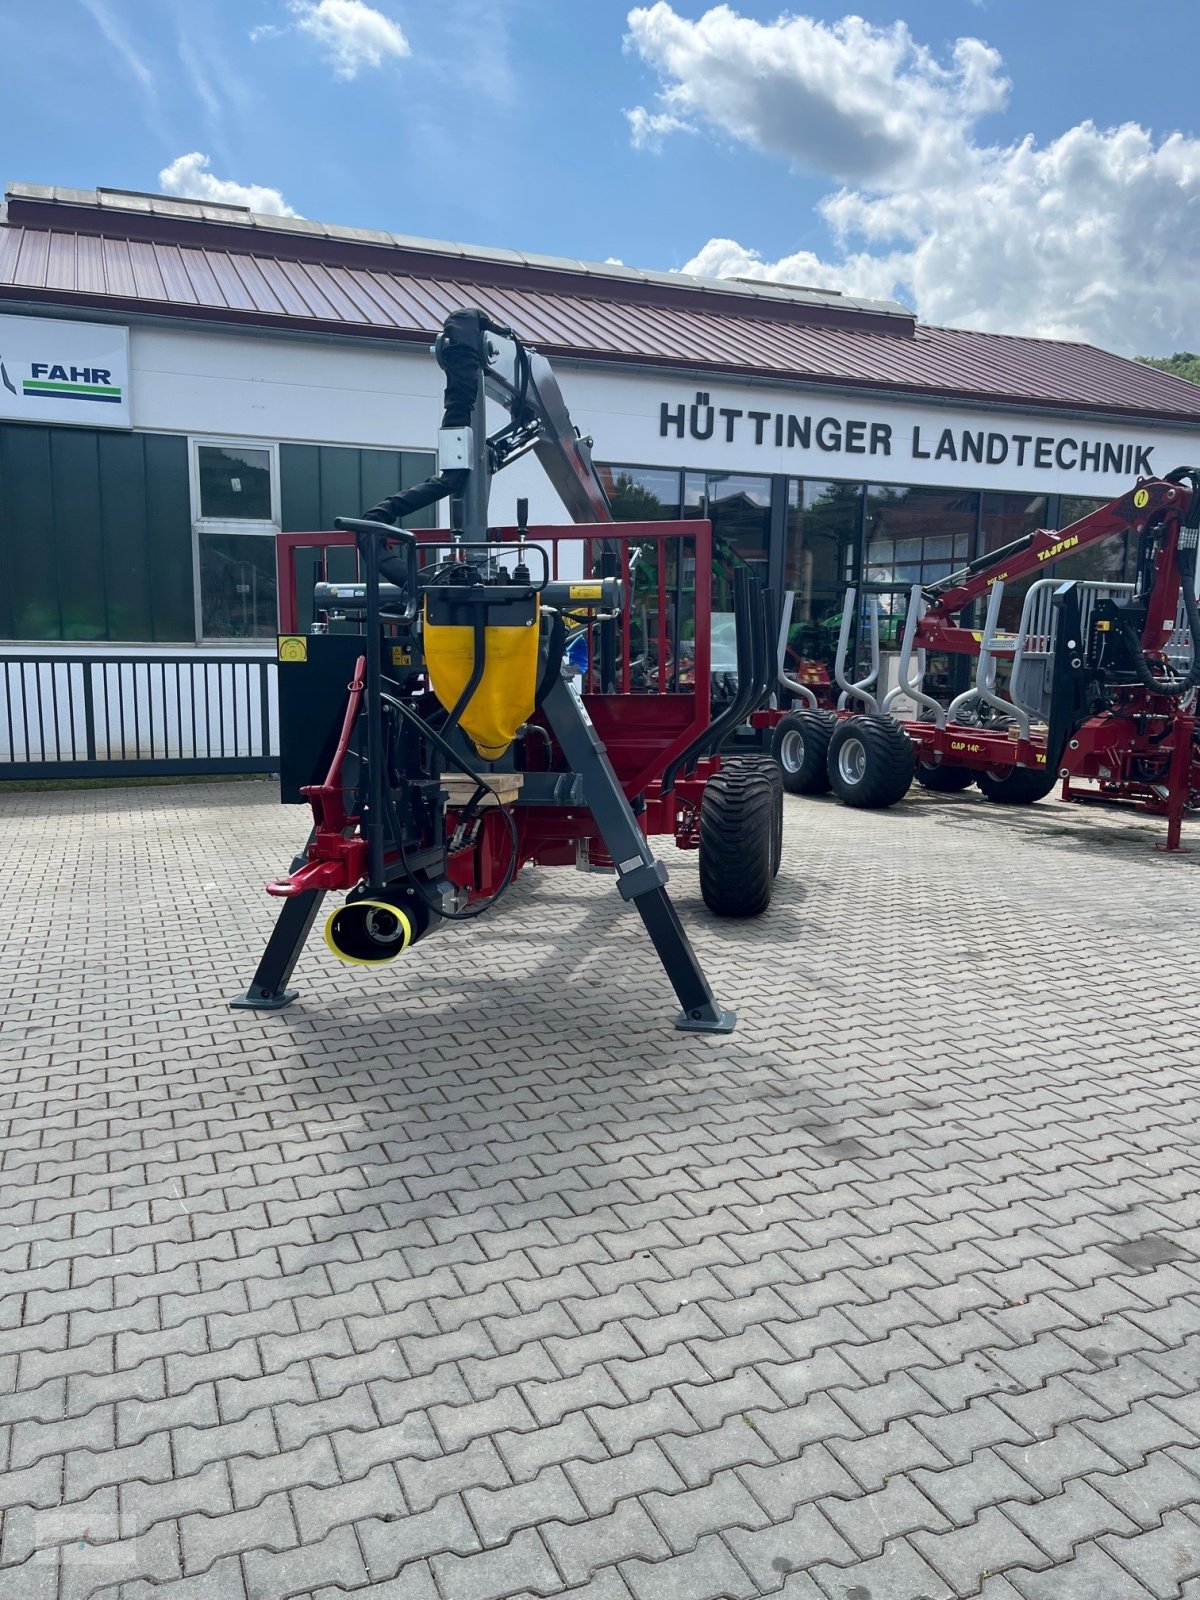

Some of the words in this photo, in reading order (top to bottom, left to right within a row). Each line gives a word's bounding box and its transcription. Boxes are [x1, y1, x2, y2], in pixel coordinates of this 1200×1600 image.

[31, 362, 112, 385] FAHR
[659, 391, 893, 456] HÜTTINGER
[911, 425, 1156, 476] LANDTECHNIK
[1037, 535, 1080, 562] TAJFUN
[951, 741, 966, 751] GAP
